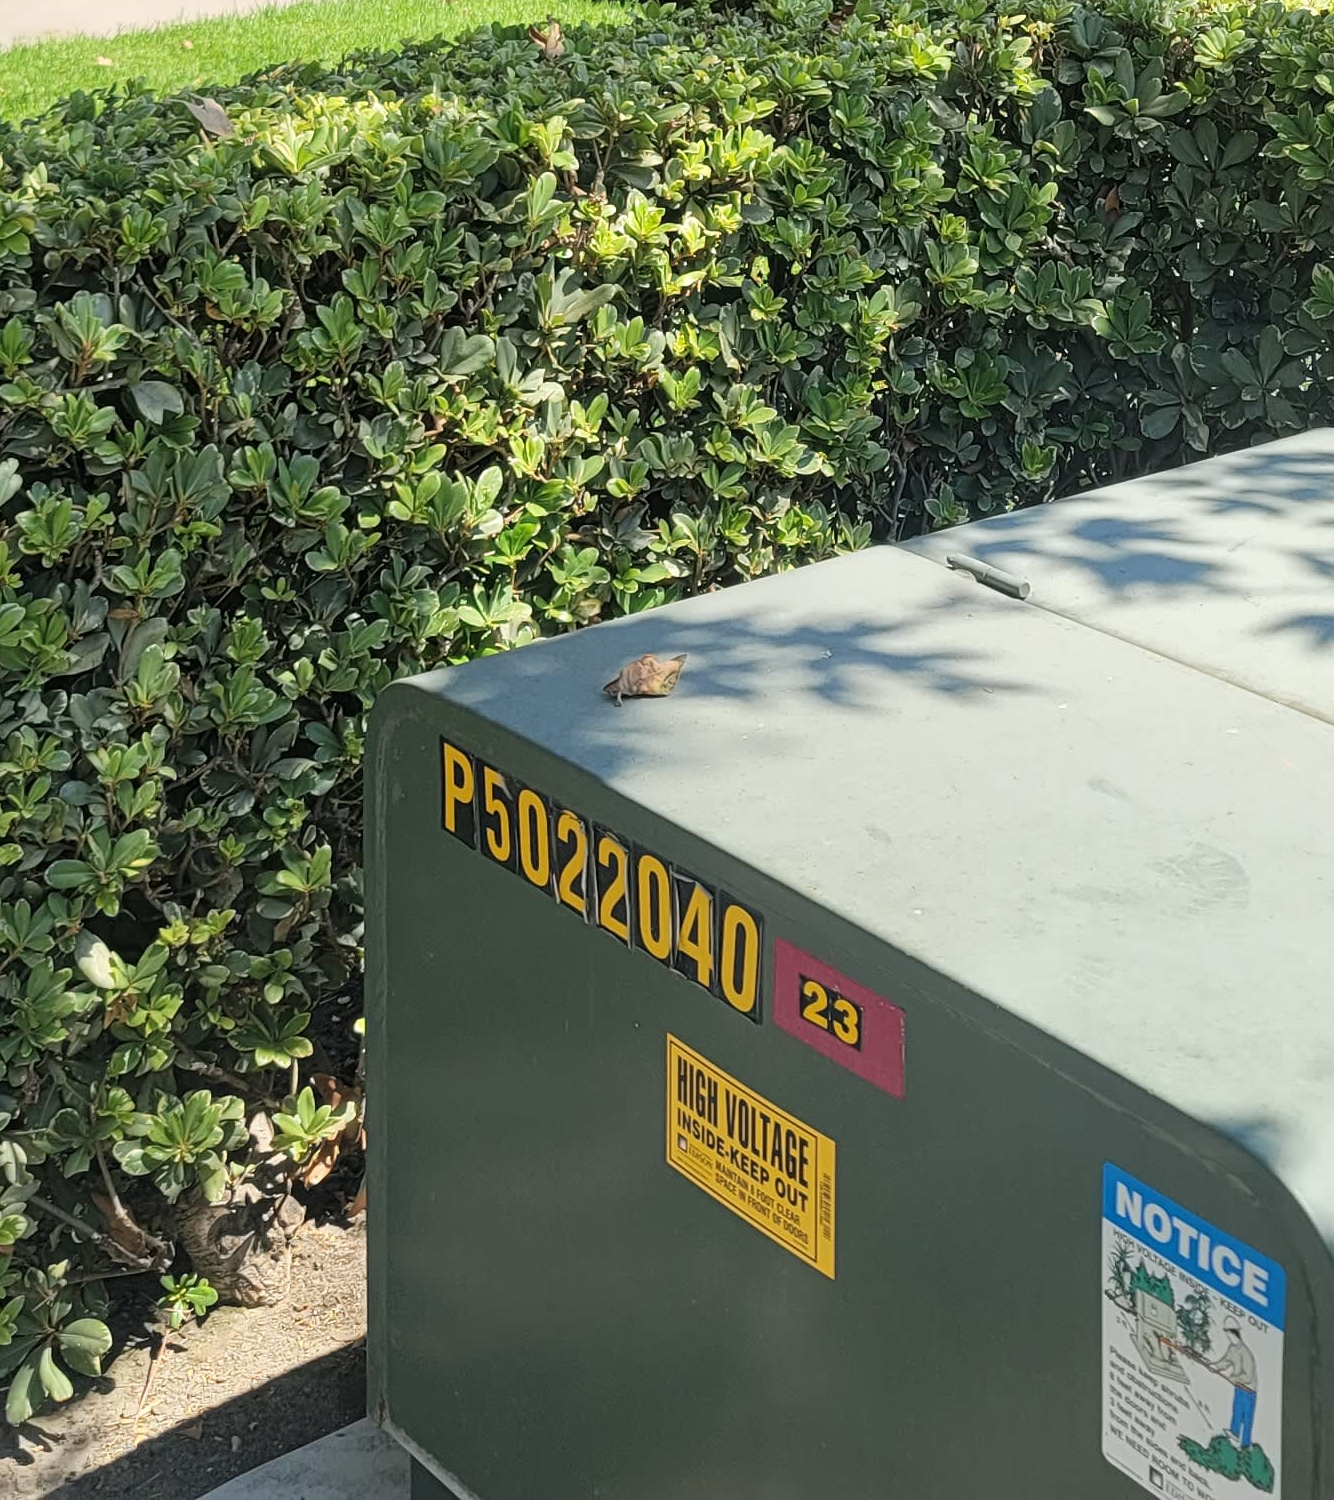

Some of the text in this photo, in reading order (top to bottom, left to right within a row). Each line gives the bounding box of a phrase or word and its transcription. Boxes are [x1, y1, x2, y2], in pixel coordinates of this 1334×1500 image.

[443, 743, 760, 1013] P5022040
[802, 980, 861, 1046] 23
[677, 1055, 809, 1189] HIGH VOLTAGE
[715, 1159, 749, 1191] MAINTAIN
[756, 1188, 774, 1209] FOOT
[777, 1202, 800, 1227] CLEAR
[715, 1173, 737, 1196] SPACE
[747, 1195, 771, 1220] FRONT
[772, 1211, 783, 1225] OF
[783, 1217, 809, 1245] DOORS
[775, 1177, 809, 1213] OUT
[1116, 1181, 1269, 1307] NOTICE
[1113, 1229, 1134, 1246] HIGH
[1137, 1245, 1178, 1277] VOLTAGE
[1179, 1273, 1210, 1296] INSIDE
[1220, 1299, 1246, 1317] KEEP
[1248, 1316, 1269, 1334] OUT
[1110, 1361, 1125, 1375] and
[1110, 1346, 1190, 1410] Please keep shrubs
[1116, 1376, 1132, 1393] feet
[1134, 1391, 1155, 1411] away
[1157, 1405, 1177, 1426] from
[1110, 1384, 1167, 1431] the doors and
[1116, 1402, 1132, 1419] feet
[1134, 1416, 1155, 1437] away
[1110, 1410, 1128, 1429] from
[1130, 1425, 1143, 1440] the
[1146, 1437, 1168, 1458] sides
[1170, 1455, 1186, 1472] and
[1110, 1424, 1124, 1440] WE
[1126, 1435, 1149, 1459] NEED
[1152, 1454, 1179, 1481] ROOM
[1182, 1476, 1194, 1491] TO
